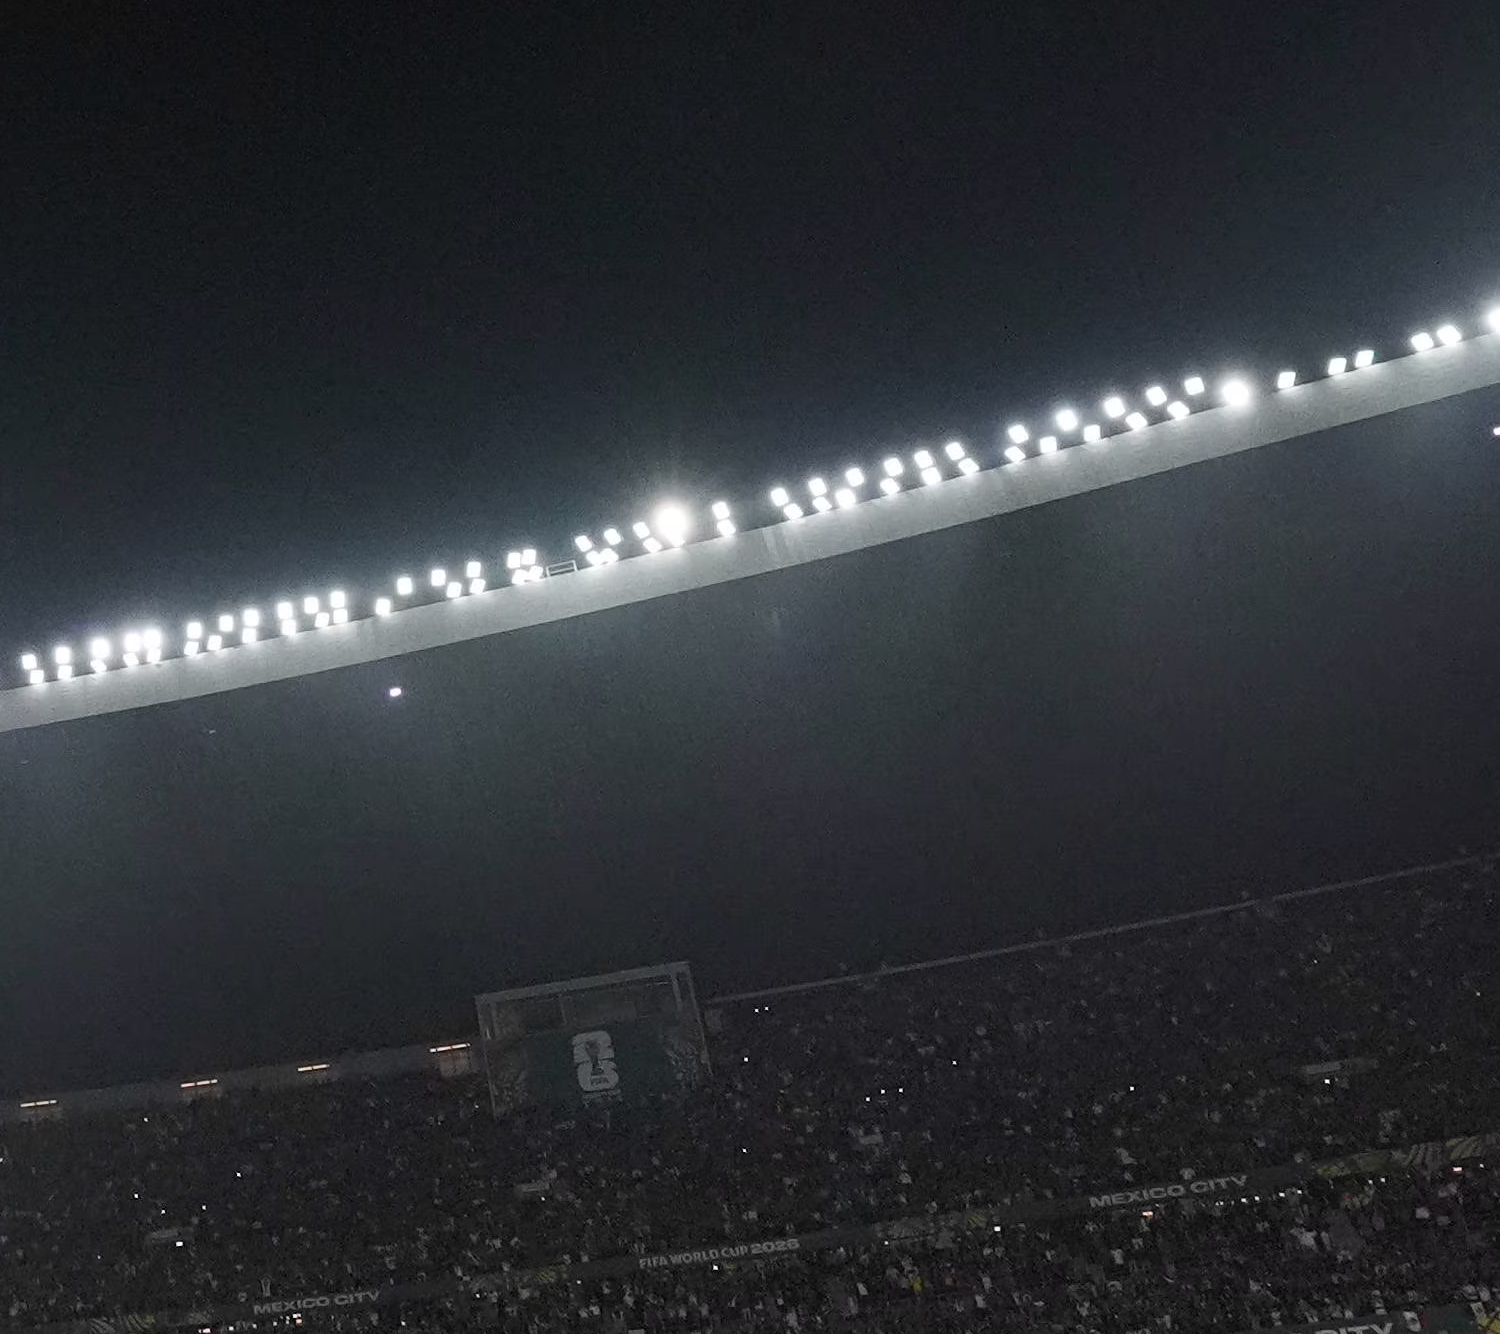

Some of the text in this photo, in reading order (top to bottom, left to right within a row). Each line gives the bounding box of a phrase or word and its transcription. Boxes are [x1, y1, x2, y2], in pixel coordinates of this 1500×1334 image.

[1089, 1175, 1247, 1208] MEXICO CITY
[639, 1253, 668, 1270] FIFA
[669, 1248, 719, 1266] WORLD
[720, 1244, 749, 1258] CUP
[253, 1291, 380, 1315] MEXICO CITY
